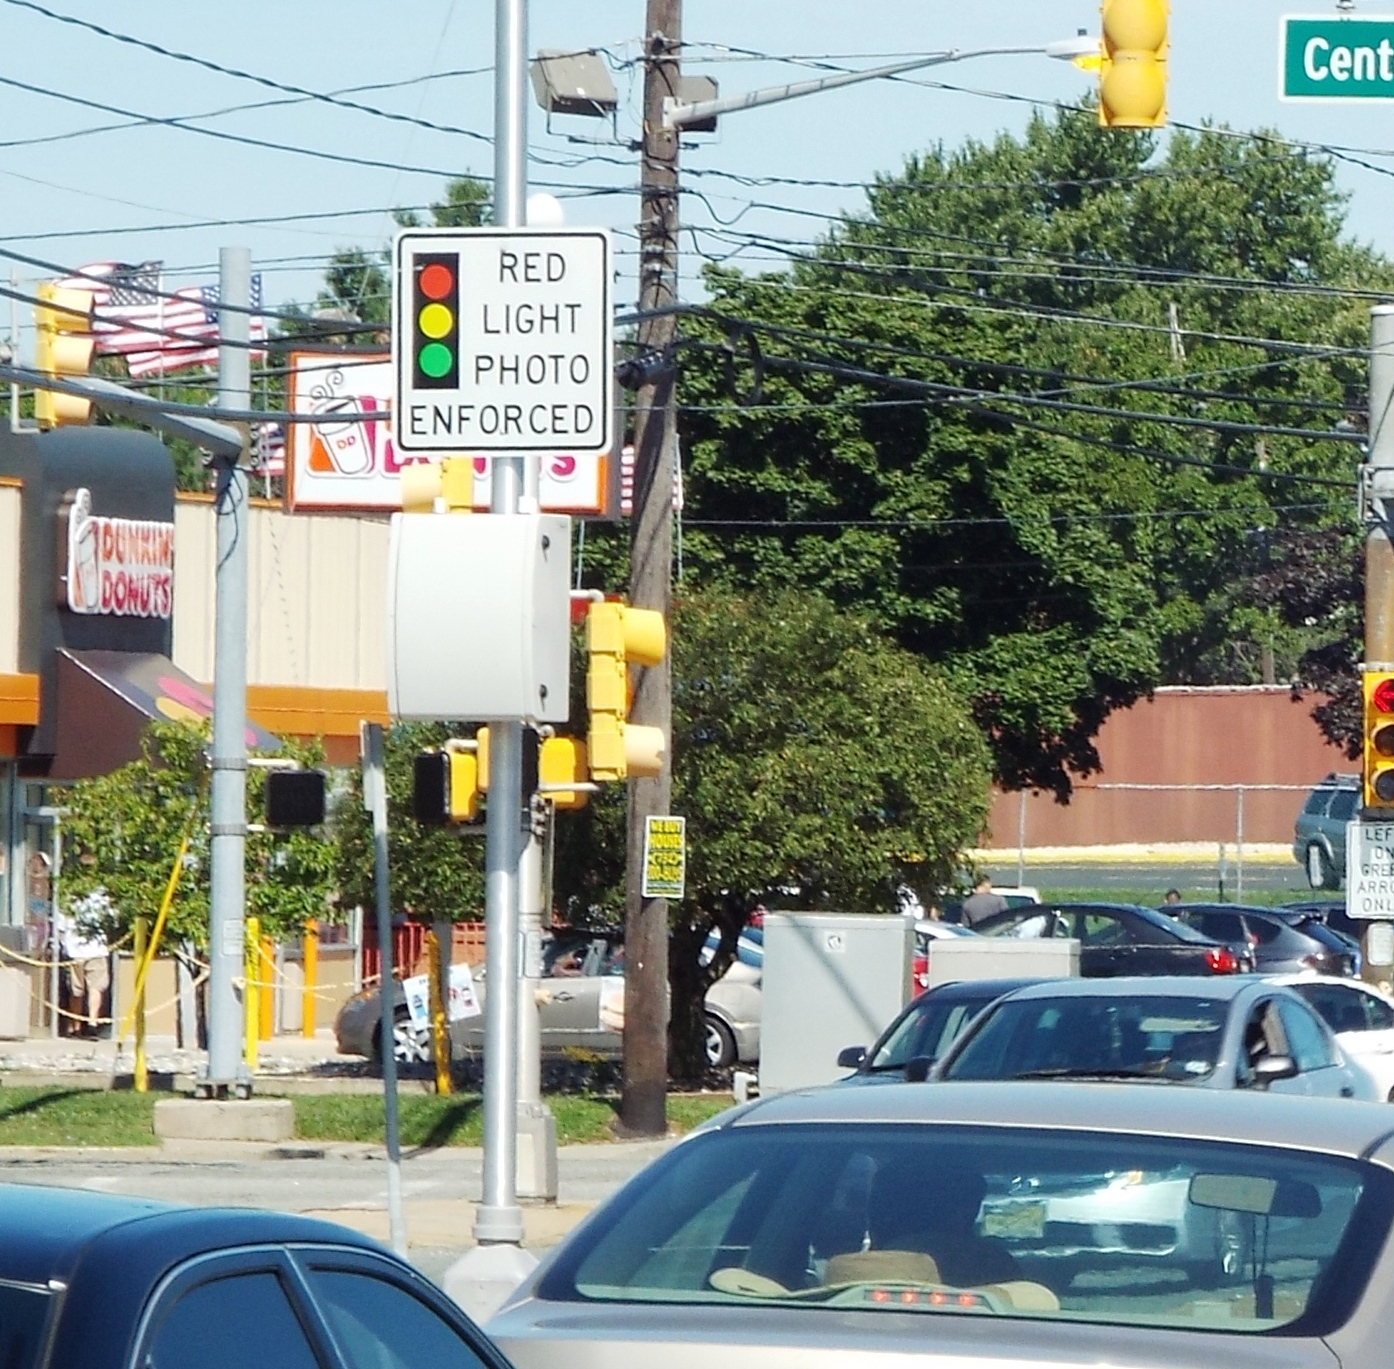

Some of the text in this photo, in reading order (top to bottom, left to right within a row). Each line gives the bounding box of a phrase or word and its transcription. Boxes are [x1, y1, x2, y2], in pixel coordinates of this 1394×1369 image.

[499, 252, 567, 282] RED
[483, 303, 582, 334] LIGHT
[475, 354, 590, 385] PHOTO
[410, 404, 593, 435] ENFORCED
[101, 570, 171, 614] DONUTS
[1374, 845, 1394, 860] ON
